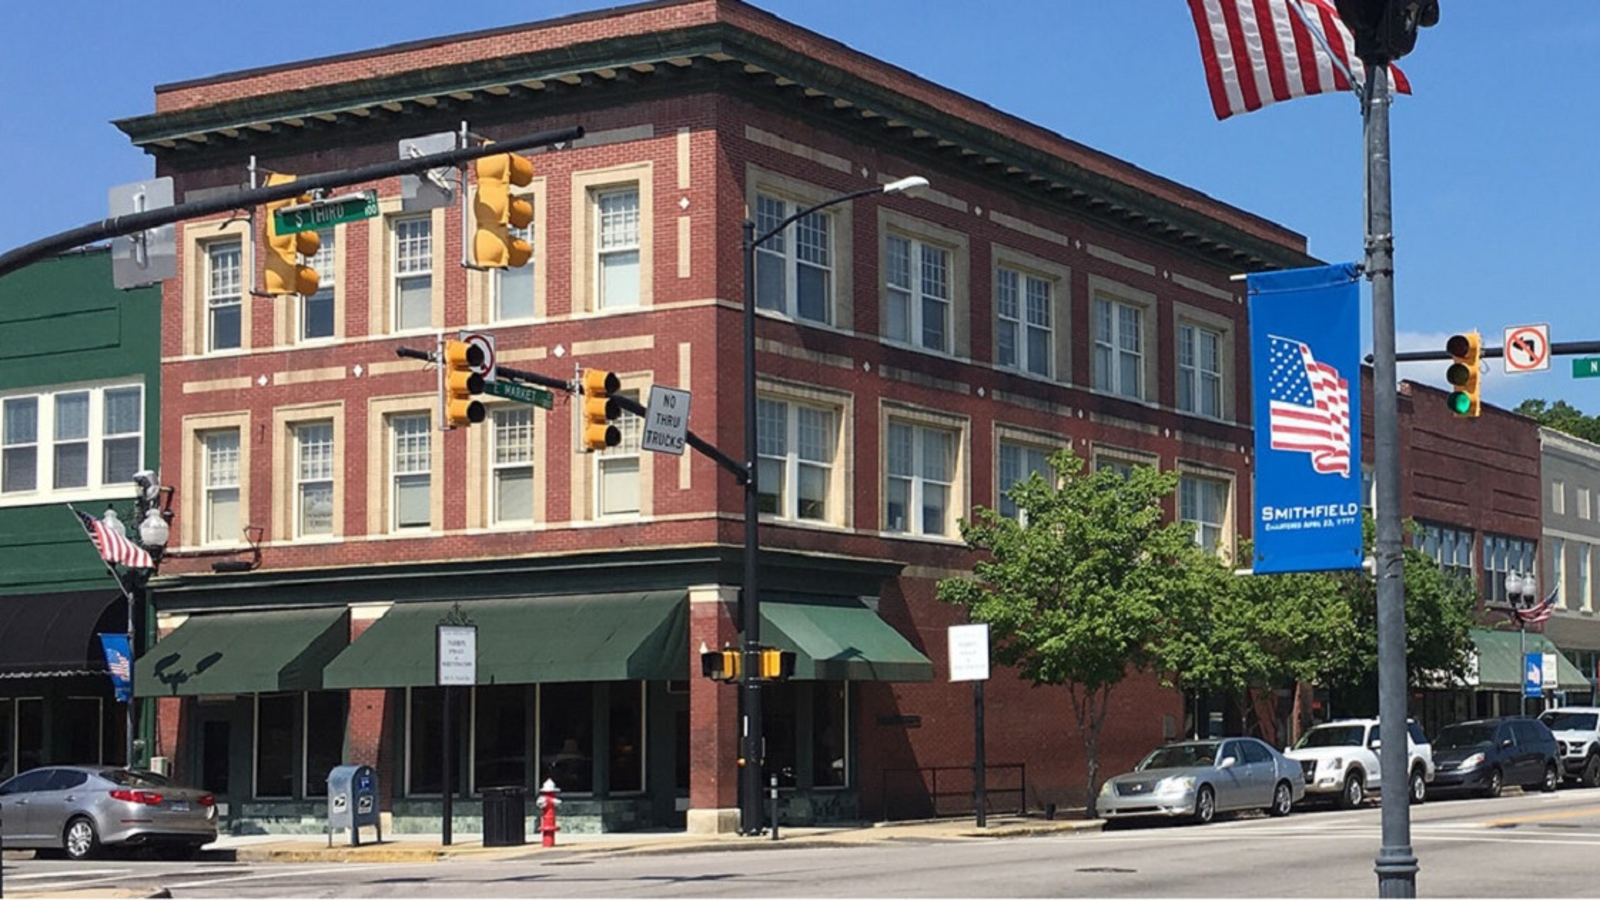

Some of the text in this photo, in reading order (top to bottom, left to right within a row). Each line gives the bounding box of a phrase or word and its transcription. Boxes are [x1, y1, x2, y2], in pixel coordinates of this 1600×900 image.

[295, 212, 303, 228] S
[311, 203, 345, 224] THIRD
[1590, 361, 1598, 373] N
[504, 384, 536, 402] MARKET
[663, 394, 677, 409] NO
[656, 412, 681, 428] THRU
[646, 430, 684, 449] TRUCKS
[1261, 503, 1359, 521] SMITHFIELD
